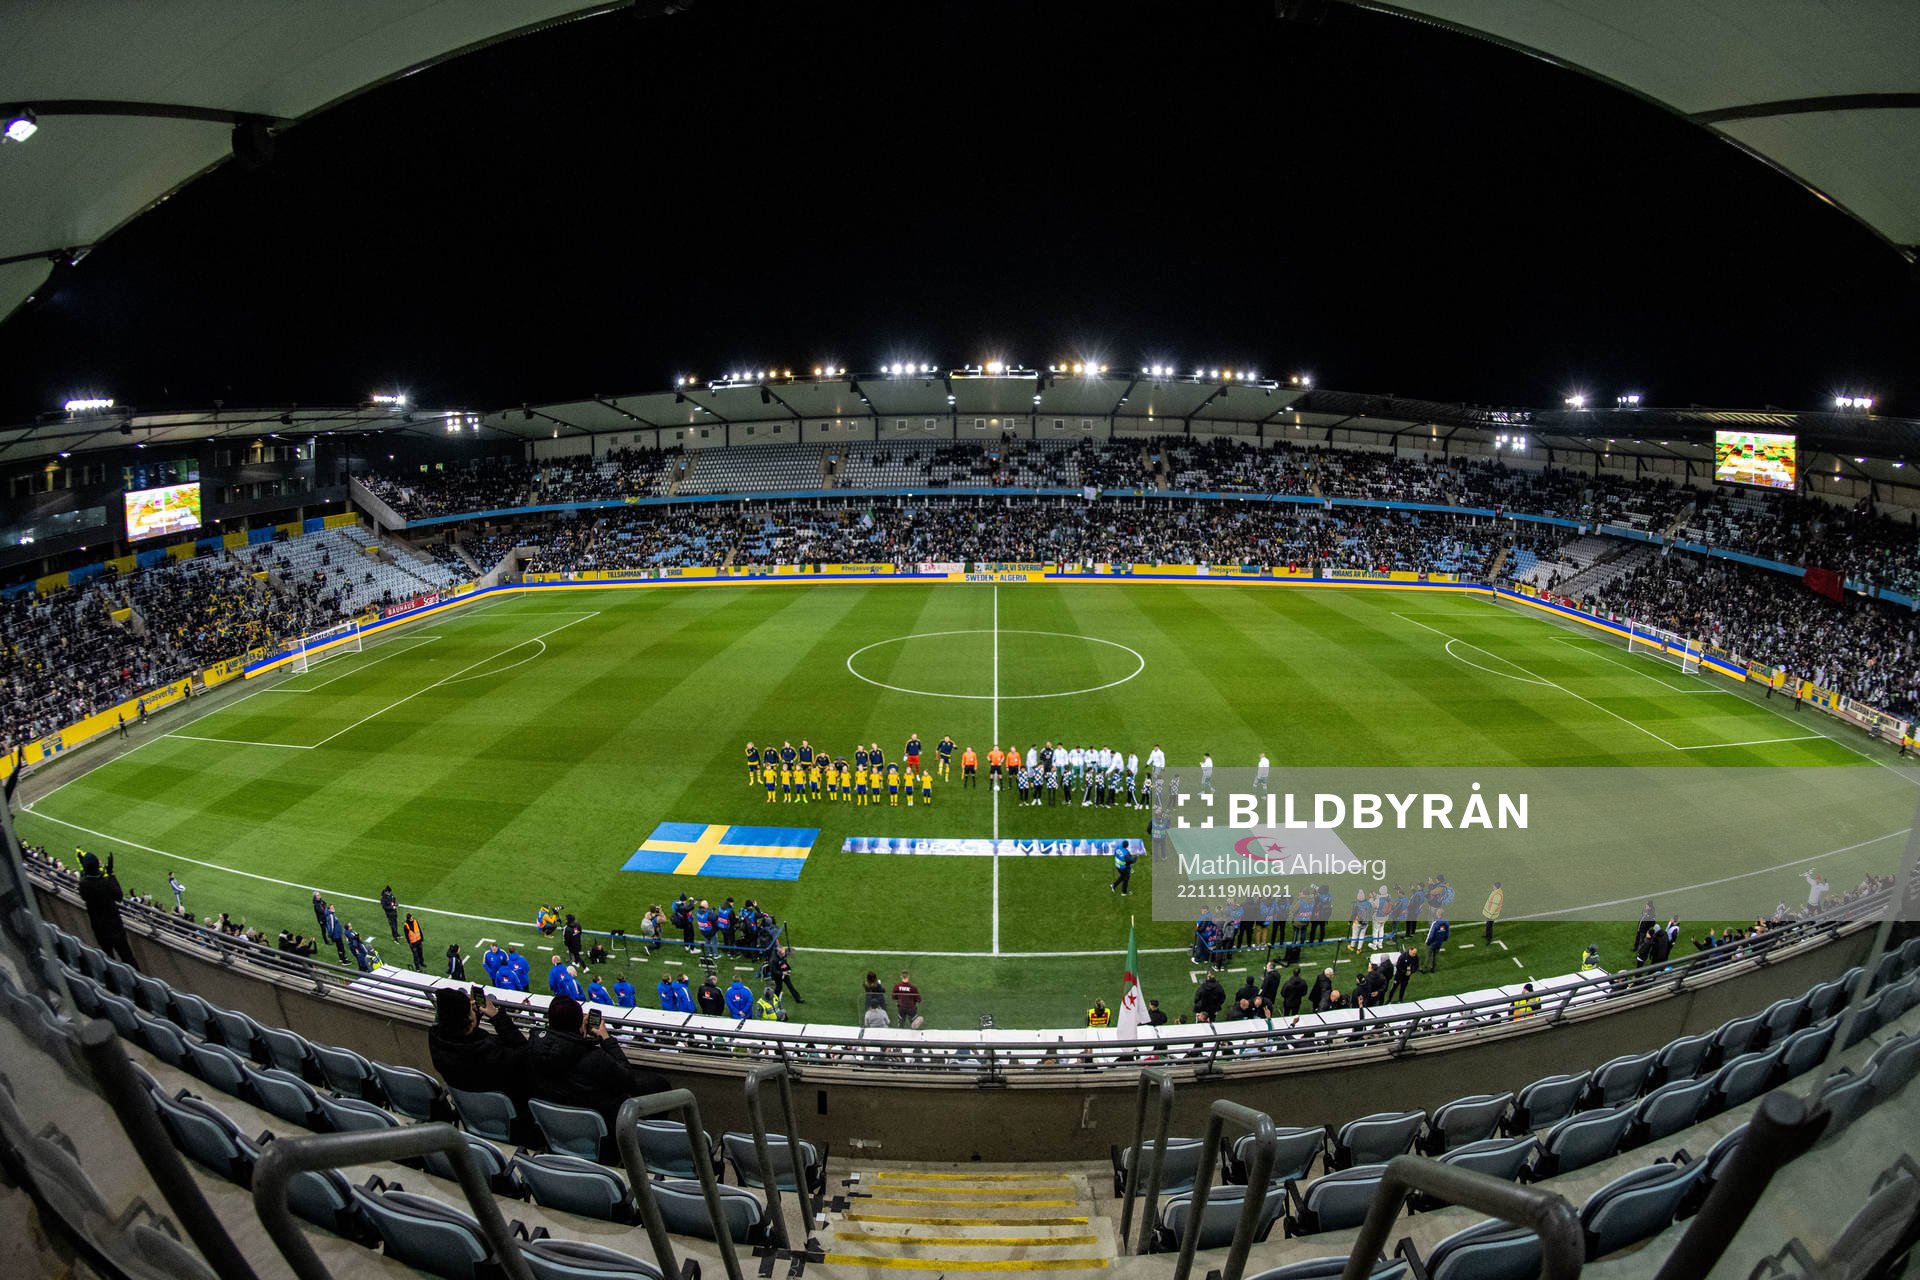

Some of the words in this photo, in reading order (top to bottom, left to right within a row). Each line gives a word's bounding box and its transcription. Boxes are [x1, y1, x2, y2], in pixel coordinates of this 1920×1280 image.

[965, 574, 994, 582] SWEDEN
[1000, 574, 1027, 582] ALGERIA
[388, 601, 415, 616] BAUHAUS
